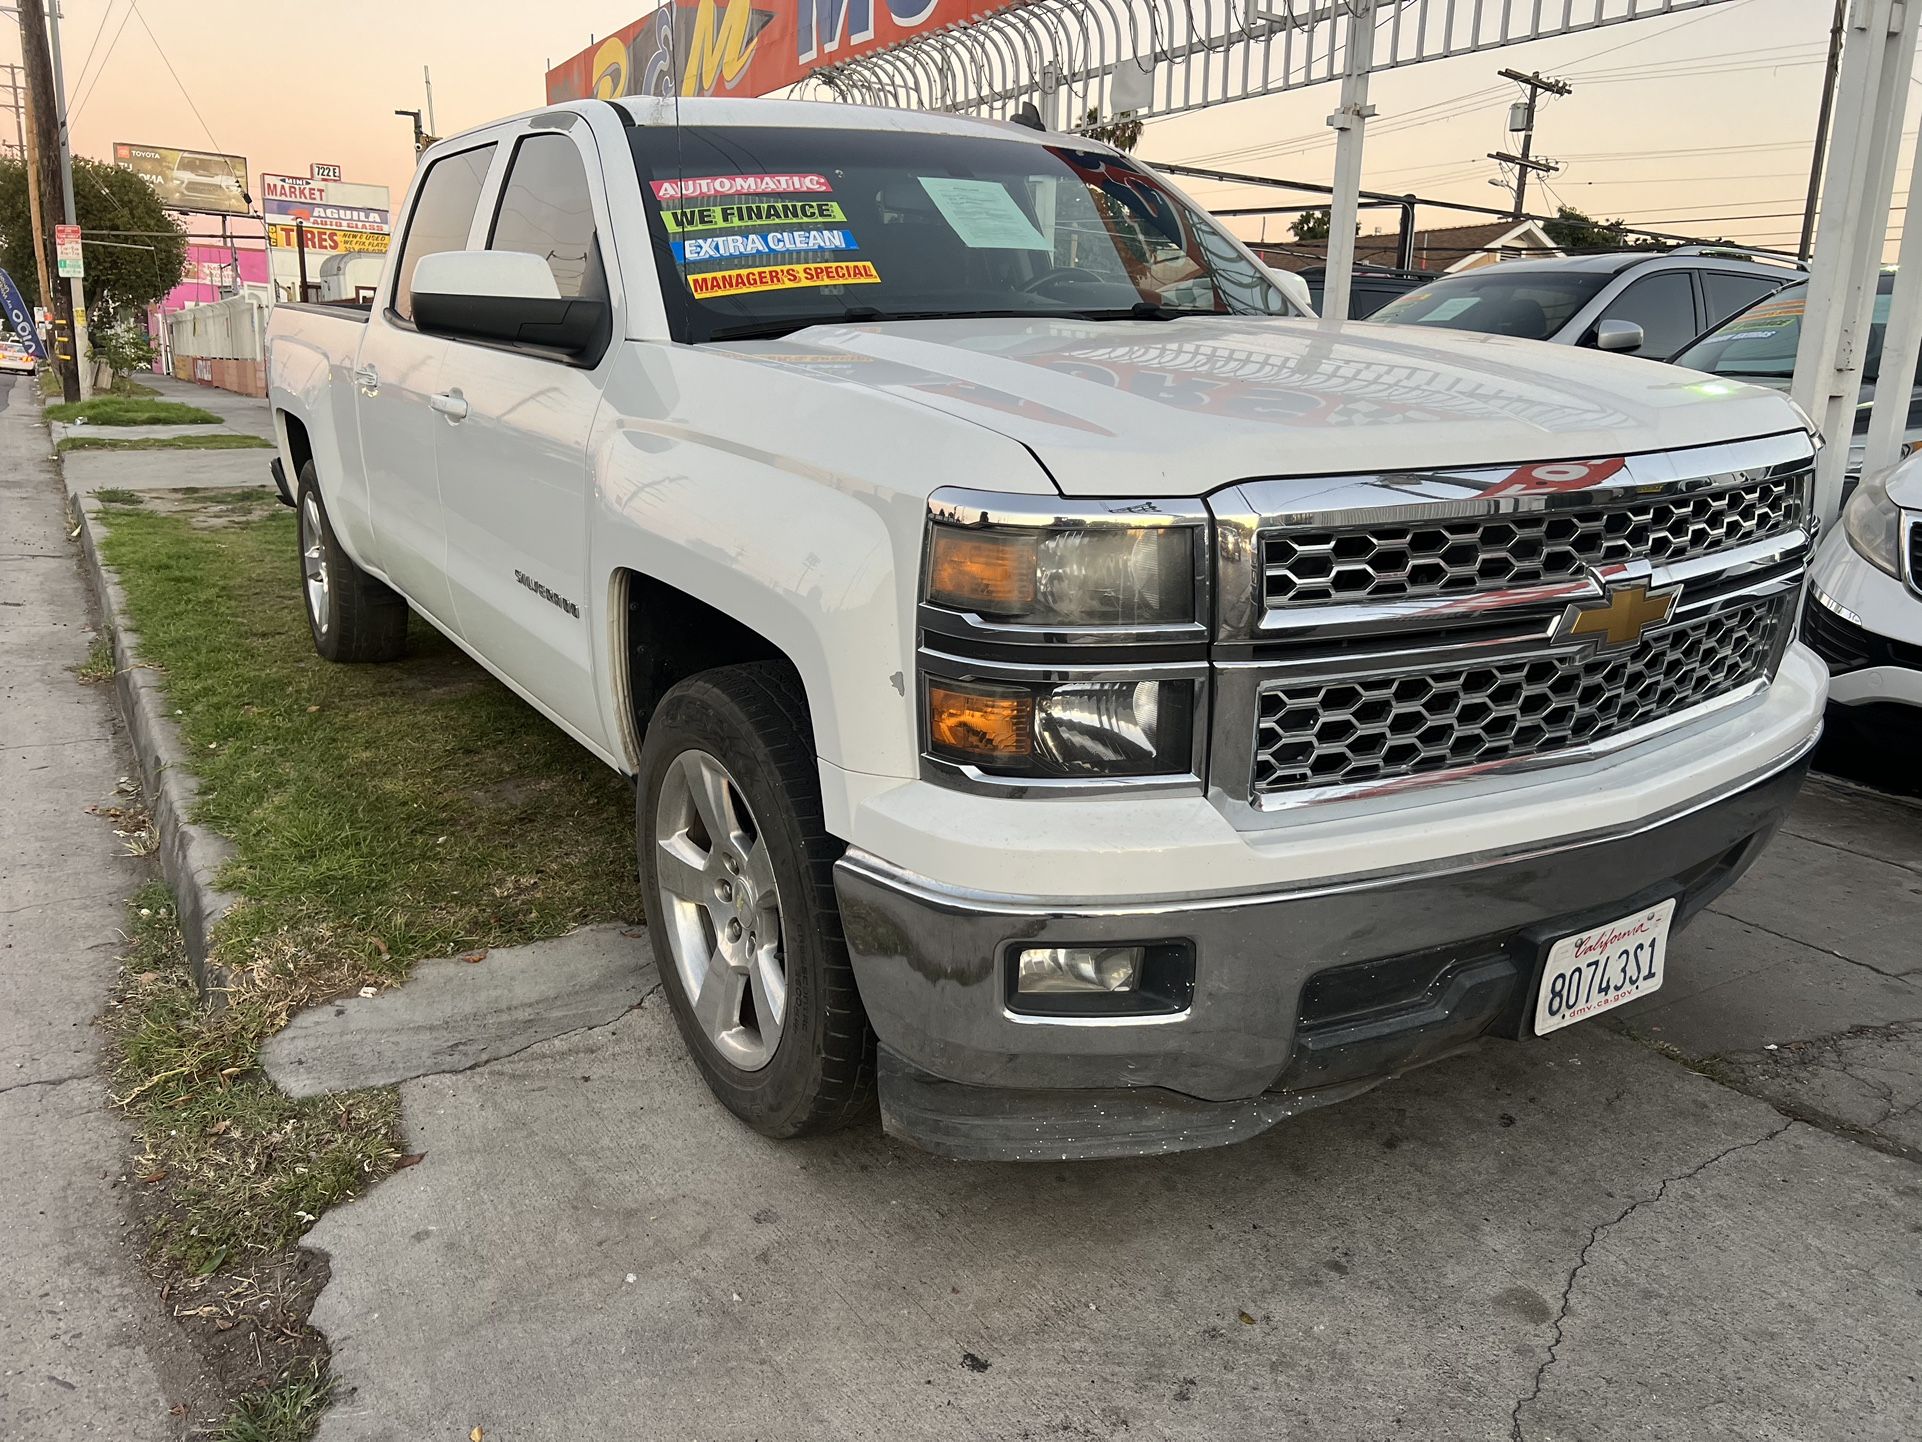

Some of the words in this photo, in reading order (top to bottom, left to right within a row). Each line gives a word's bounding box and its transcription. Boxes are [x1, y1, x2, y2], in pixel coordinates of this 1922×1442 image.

[131, 150, 160, 159] TOYOTA
[285, 178, 306, 186] MINI
[315, 165, 331, 178] 722
[266, 183, 325, 201] MARKET
[658, 175, 826, 197] AUTOMATIC
[311, 219, 343, 228] AUTO
[346, 222, 384, 232] GLASS
[312, 207, 381, 222] AGUILA
[671, 207, 715, 228] WE
[720, 202, 834, 223] FINANCE
[280, 227, 339, 250] TRES
[342, 232, 358, 240] NEW
[685, 235, 764, 260] EXTRA
[767, 229, 845, 250] CLEAN
[693, 268, 799, 295] MANAGER'S
[803, 263, 875, 282] SPECIAL
[1575, 923, 1649, 958] California
[1547, 936, 1656, 1017] 80743S1
[1569, 987, 1633, 1018] dmv.ca.gov
